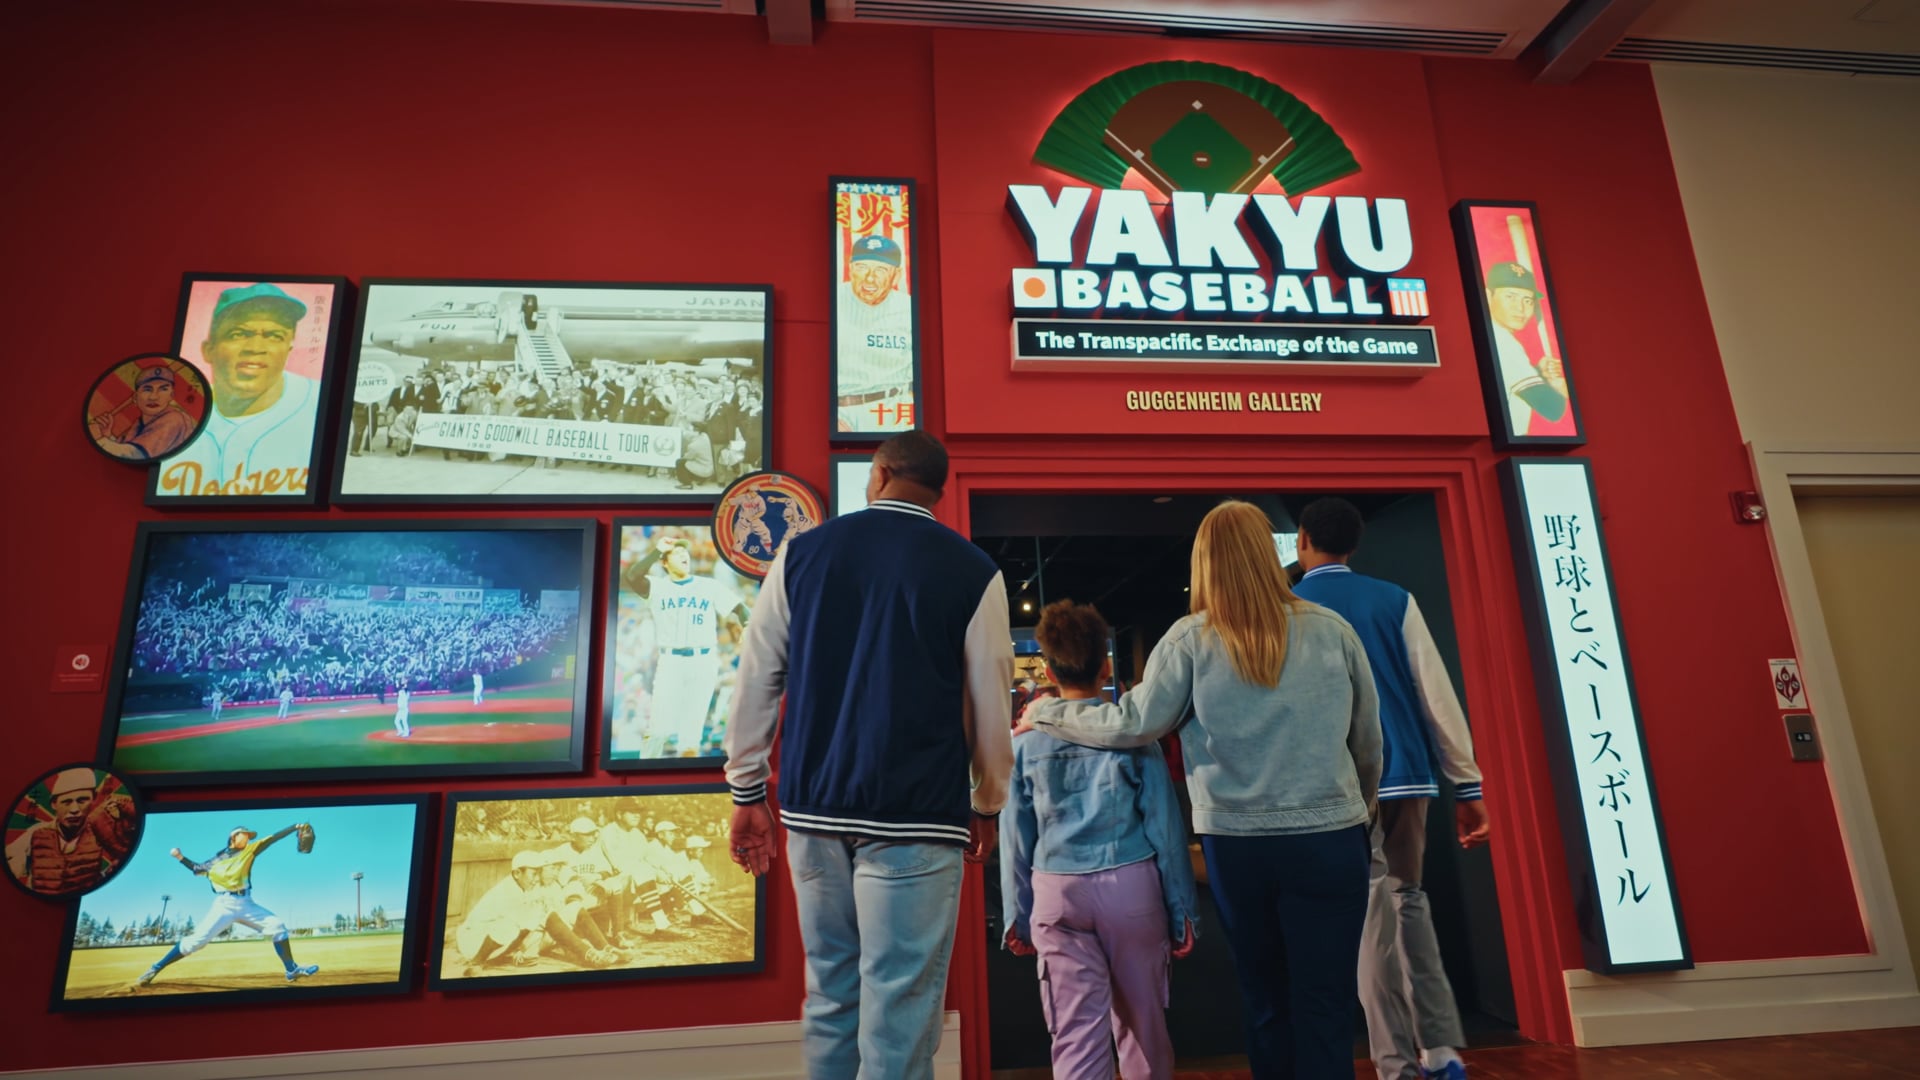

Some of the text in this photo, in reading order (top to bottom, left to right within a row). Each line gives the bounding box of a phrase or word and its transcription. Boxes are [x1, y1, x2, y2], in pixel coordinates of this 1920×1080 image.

[1007, 183, 1413, 273] YAKYU
[685, 296, 764, 308] JAPAN
[1060, 267, 1383, 315] BASEBALL
[866, 334, 907, 350] SEALS
[1035, 331, 1418, 356] The Transpacific Exchange of the Game
[1126, 390, 1322, 412] GUGGENHEIM GALLERY
[869, 403, 915, 426] 十月
[440, 421, 481, 440] GIANTS
[484, 423, 539, 446] GOODWILL
[545, 428, 609, 451] BASEBALL
[617, 433, 649, 454] TOUR
[572, 451, 613, 460] TOKYO
[661, 596, 709, 611] JAPAN
[692, 613, 704, 625] 16
[1543, 514, 1652, 906] 野球とベースボール
